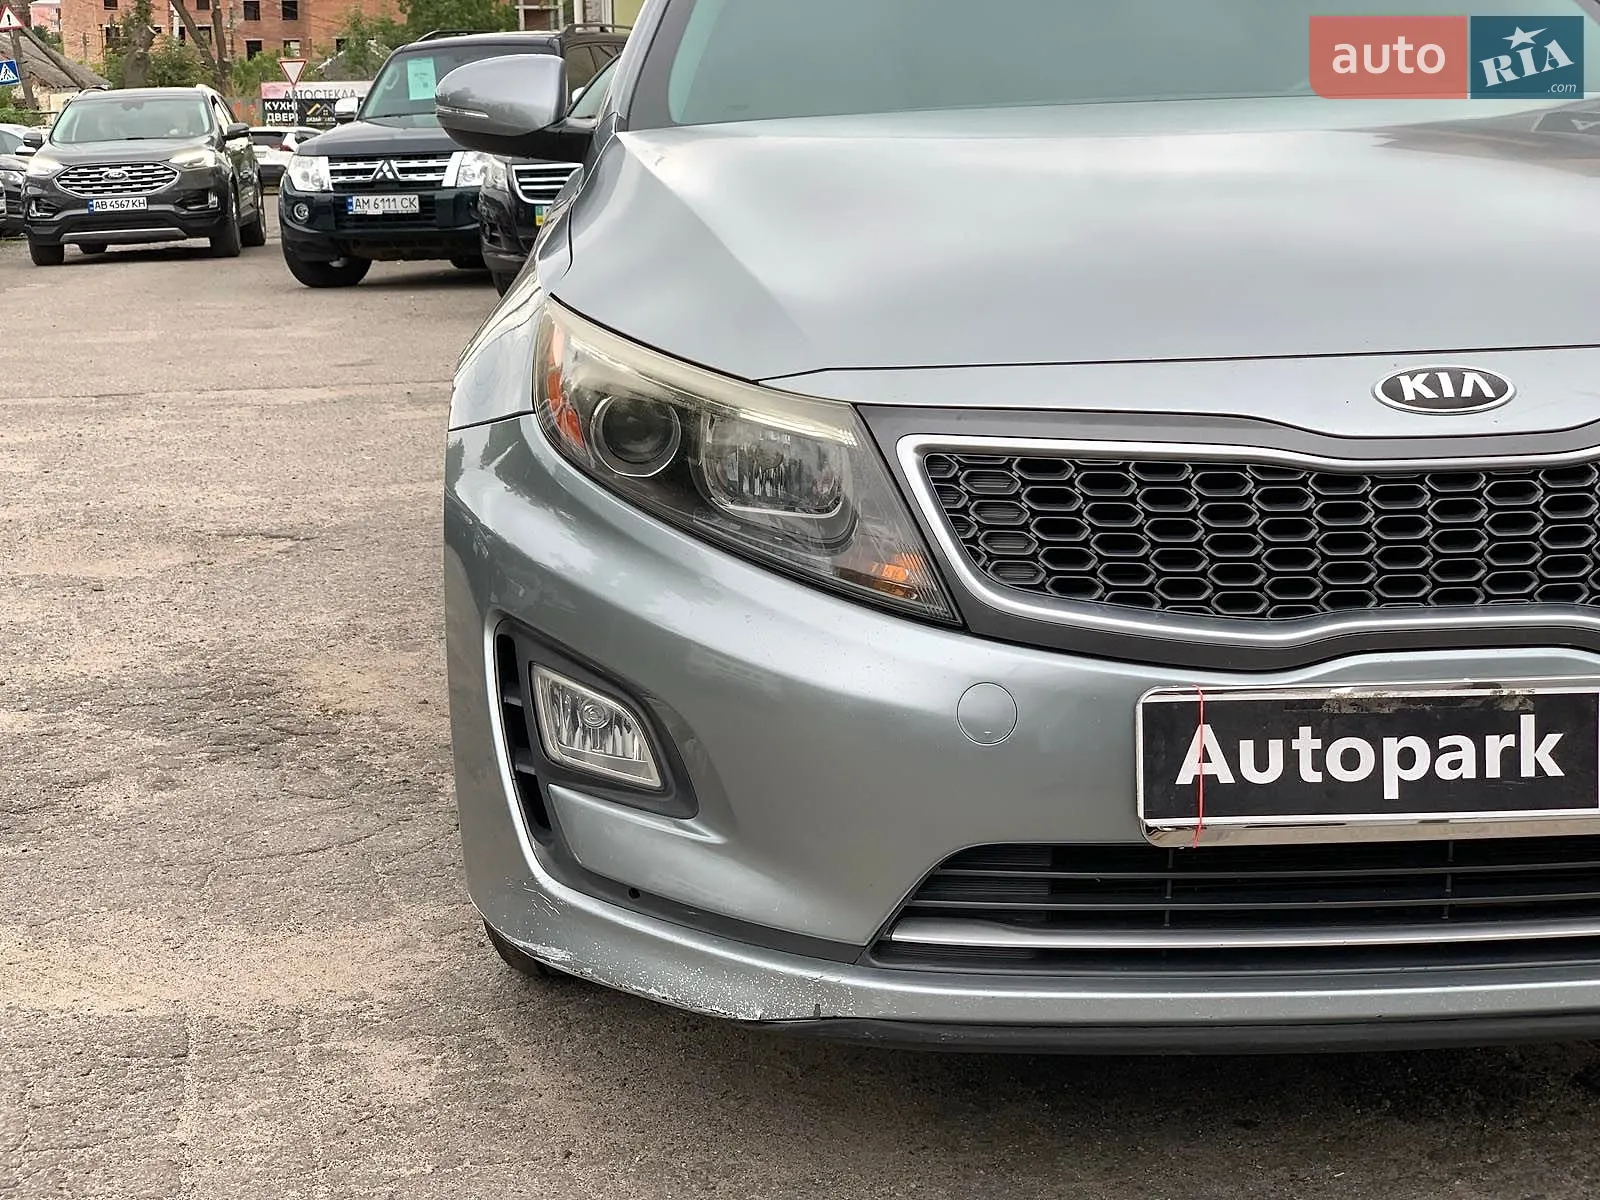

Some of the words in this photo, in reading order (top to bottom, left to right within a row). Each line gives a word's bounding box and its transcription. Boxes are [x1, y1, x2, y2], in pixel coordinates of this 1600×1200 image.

[95, 201, 108, 210] AB
[109, 200, 130, 209] 4567
[131, 199, 146, 208] KH
[355, 198, 370, 210] AM
[373, 198, 397, 210] 6111
[400, 197, 417, 209] CK
[1397, 372, 1496, 400] KIA
[1175, 714, 1565, 800] Autopark
